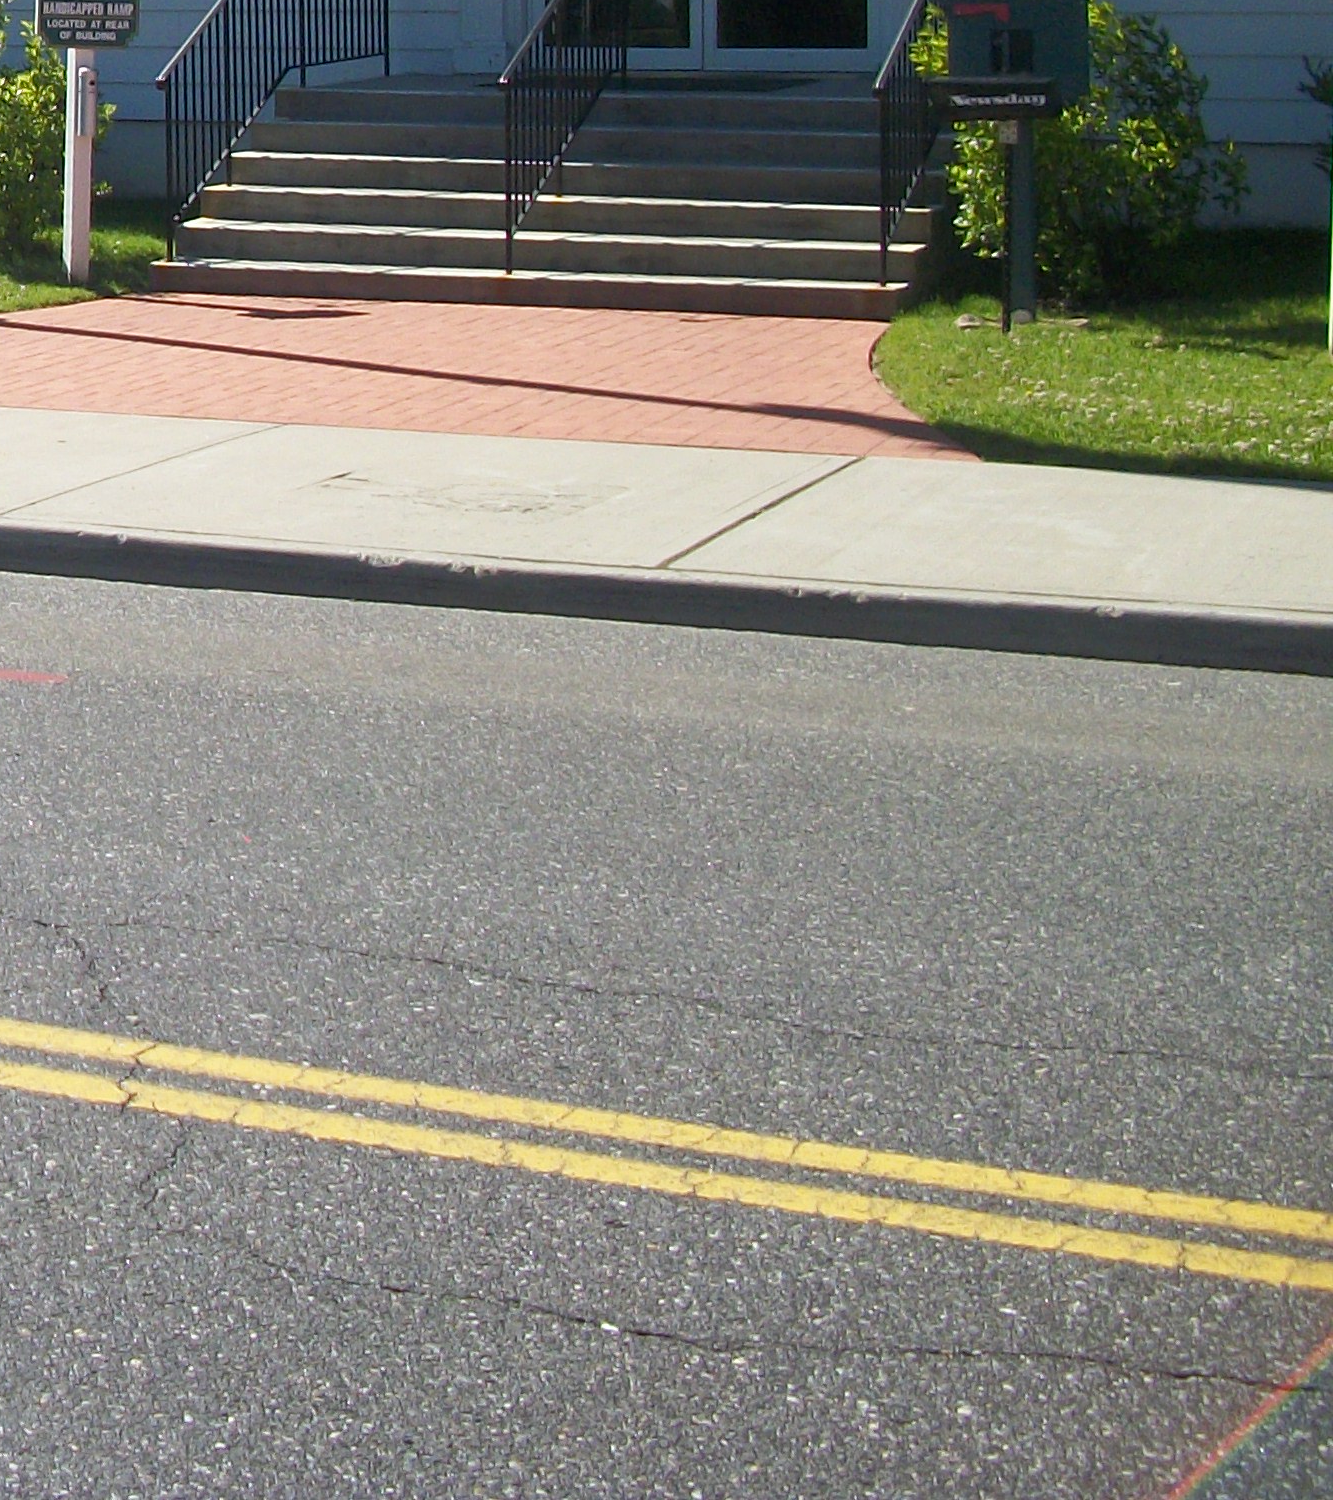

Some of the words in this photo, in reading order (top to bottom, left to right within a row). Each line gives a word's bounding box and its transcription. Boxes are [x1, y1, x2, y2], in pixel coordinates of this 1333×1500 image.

[43, 2, 104, 16] HANDICAPPED
[107, 2, 134, 16] RAMP
[47, 19, 86, 29] LOCATED
[90, 20, 101, 29] AT
[105, 20, 130, 29] REAR
[59, 30, 72, 40] OF
[75, 31, 117, 41] BUILDING
[950, 93, 1046, 107] Newsday
